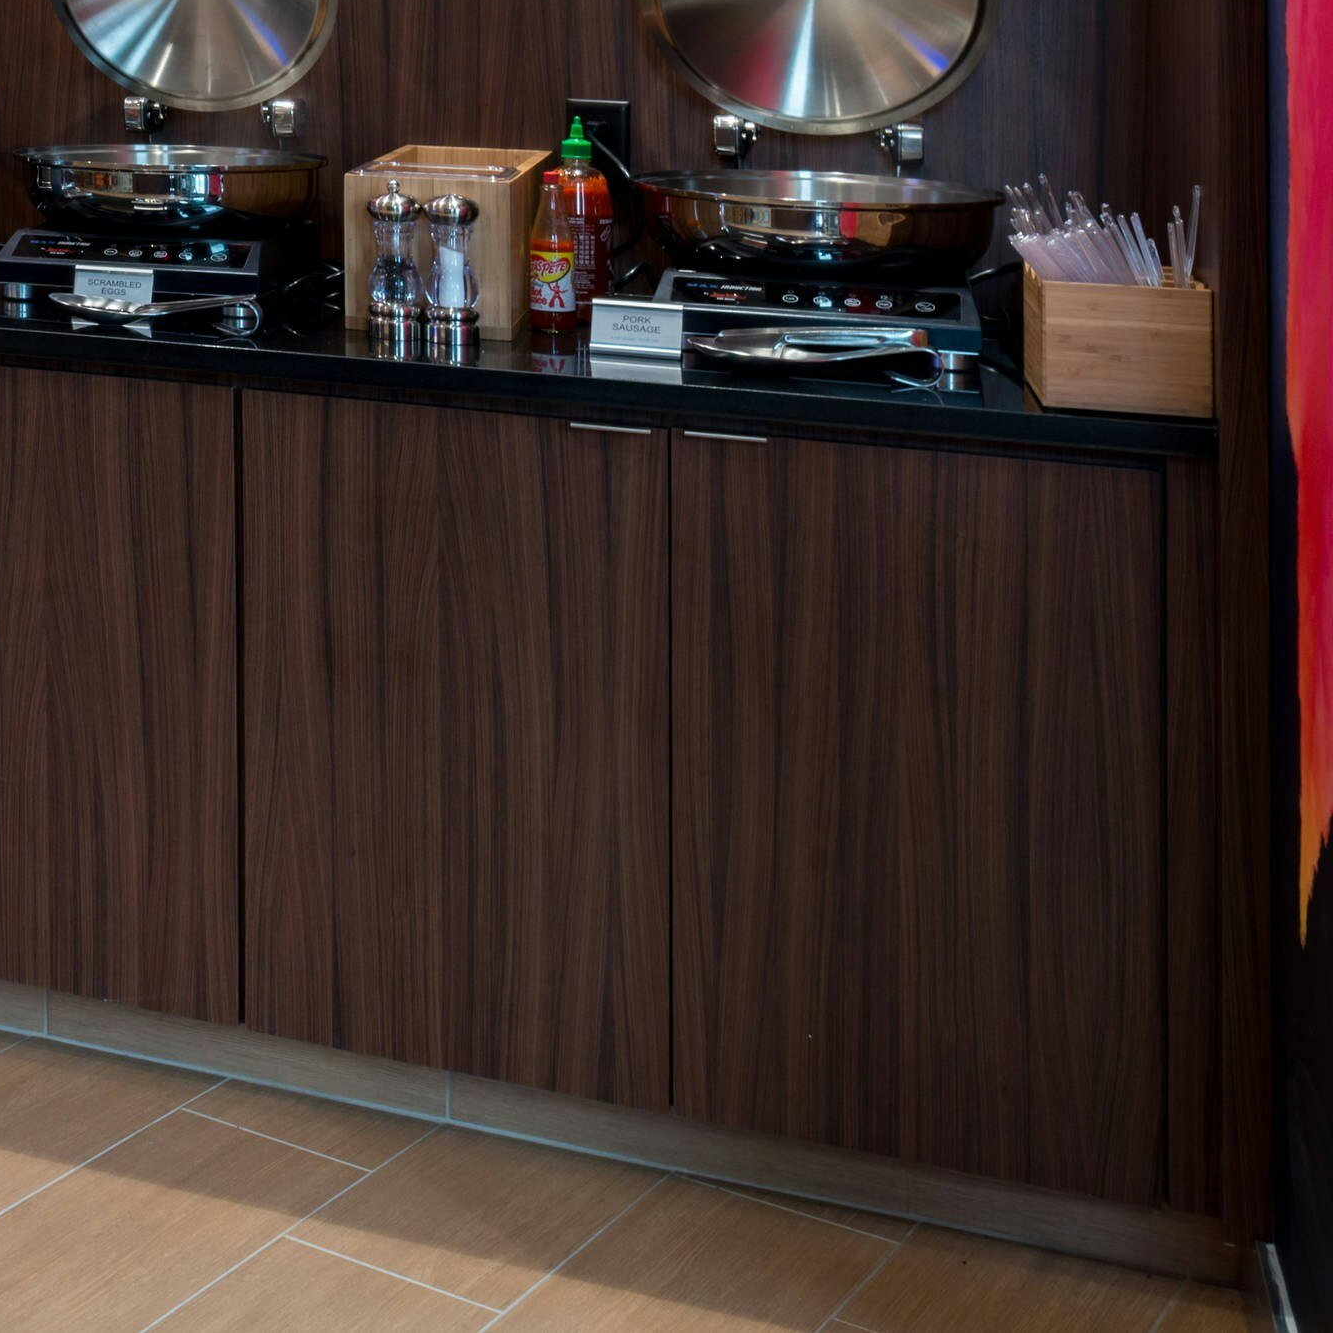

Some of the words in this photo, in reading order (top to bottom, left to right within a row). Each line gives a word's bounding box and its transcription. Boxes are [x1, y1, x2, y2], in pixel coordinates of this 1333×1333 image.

[87, 278, 142, 289] SCRAMBLED
[101, 287, 127, 296] EGGS
[621, 315, 652, 325] PORK
[612, 323, 661, 335] SAUSAGE
